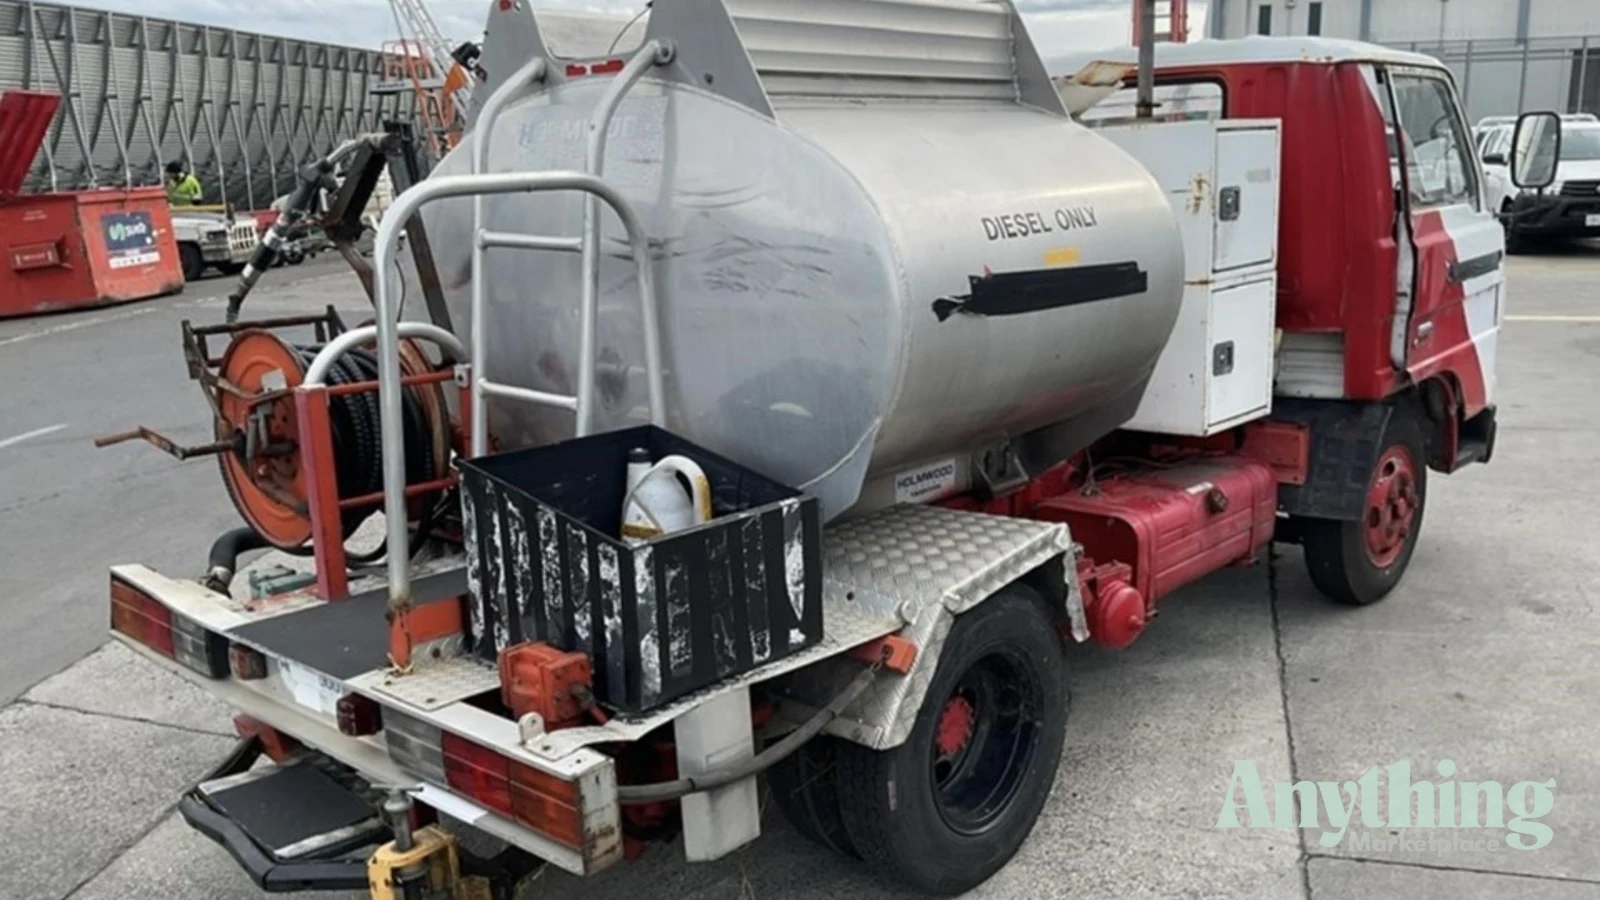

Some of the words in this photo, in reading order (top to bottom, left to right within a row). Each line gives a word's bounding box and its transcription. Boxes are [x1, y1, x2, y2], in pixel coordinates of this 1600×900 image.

[981, 212, 1052, 241] DIESEL
[1055, 206, 1098, 231] ONLY
[897, 464, 953, 488] HOLMWOOD
